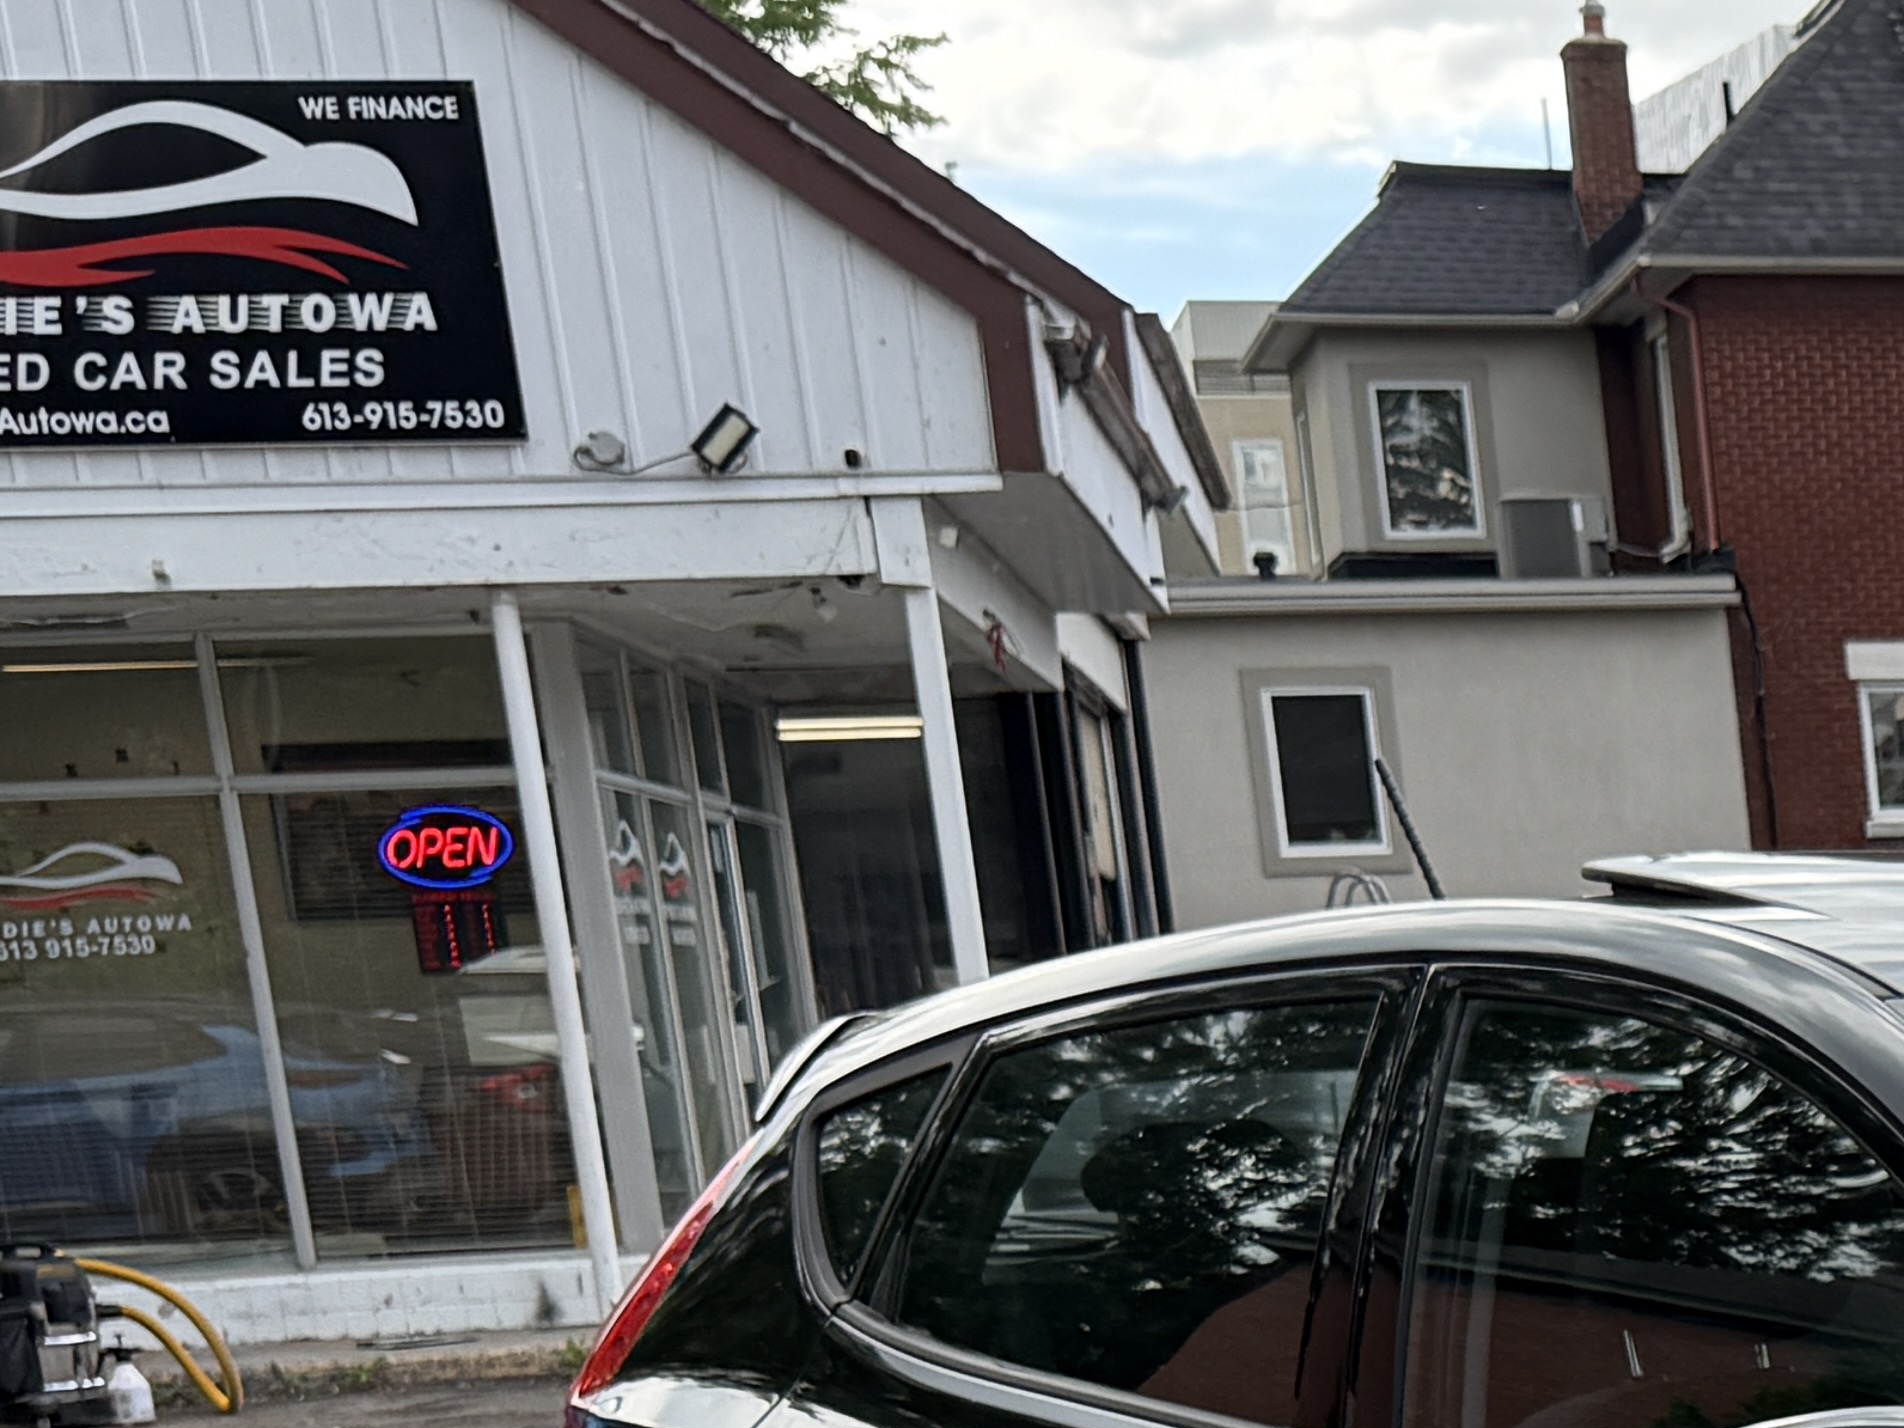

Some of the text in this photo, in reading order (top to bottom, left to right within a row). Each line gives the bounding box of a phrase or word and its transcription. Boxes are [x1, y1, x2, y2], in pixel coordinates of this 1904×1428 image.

[299, 95, 459, 120] WE FINANCE
[170, 291, 438, 334] AUTOWA
[74, 350, 187, 391] CAR
[209, 348, 385, 389] SALES
[0, 400, 504, 435] Autowa.ca 613-915-7530
[384, 826, 499, 869] OPEN
[87, 912, 192, 934] AUTOWA
[45, 933, 156, 959] 915-7530
